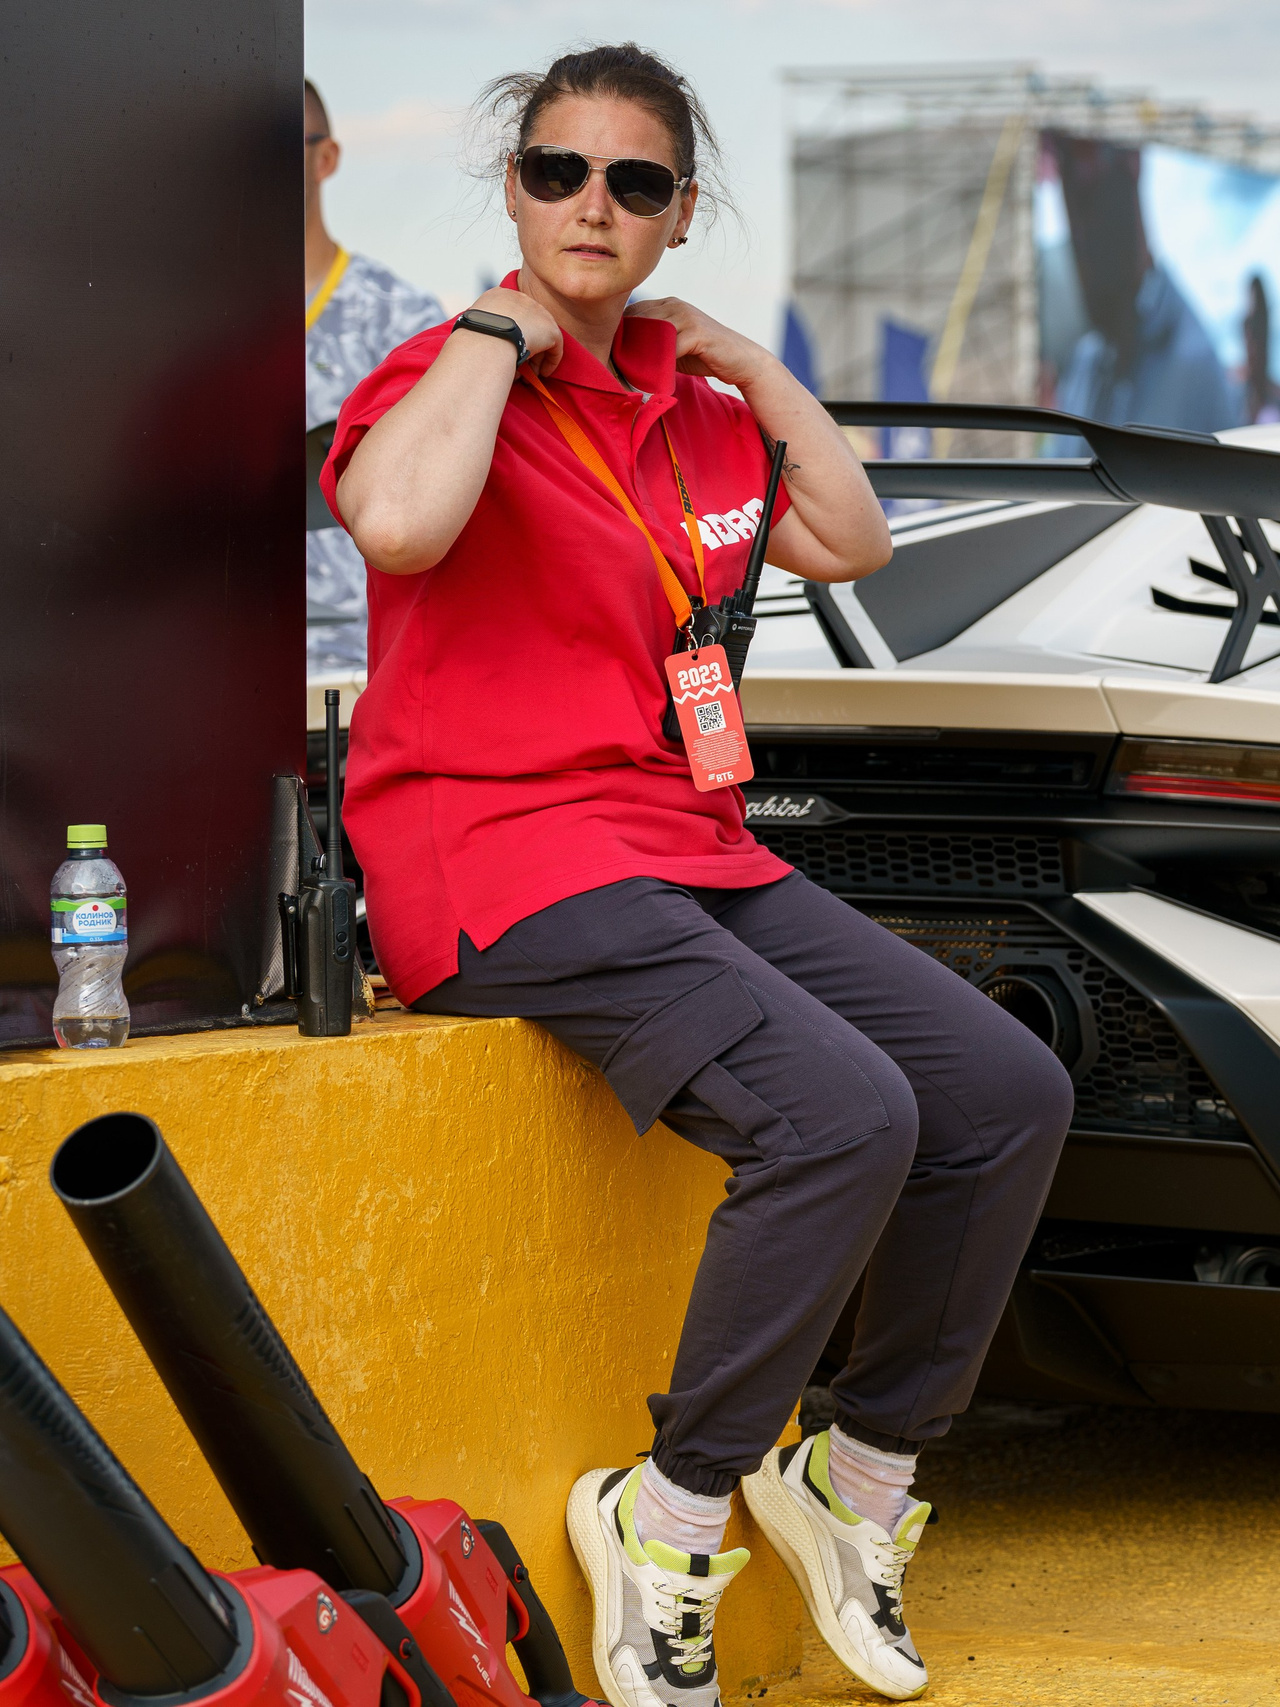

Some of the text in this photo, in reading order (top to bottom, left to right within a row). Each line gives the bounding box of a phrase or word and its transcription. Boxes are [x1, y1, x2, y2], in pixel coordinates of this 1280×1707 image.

[677, 662, 723, 690] 2023
[715, 771, 734, 783] ВТБ
[78, 919, 112, 927] РОДНИК
[472, 1653, 492, 1689] FUEL
